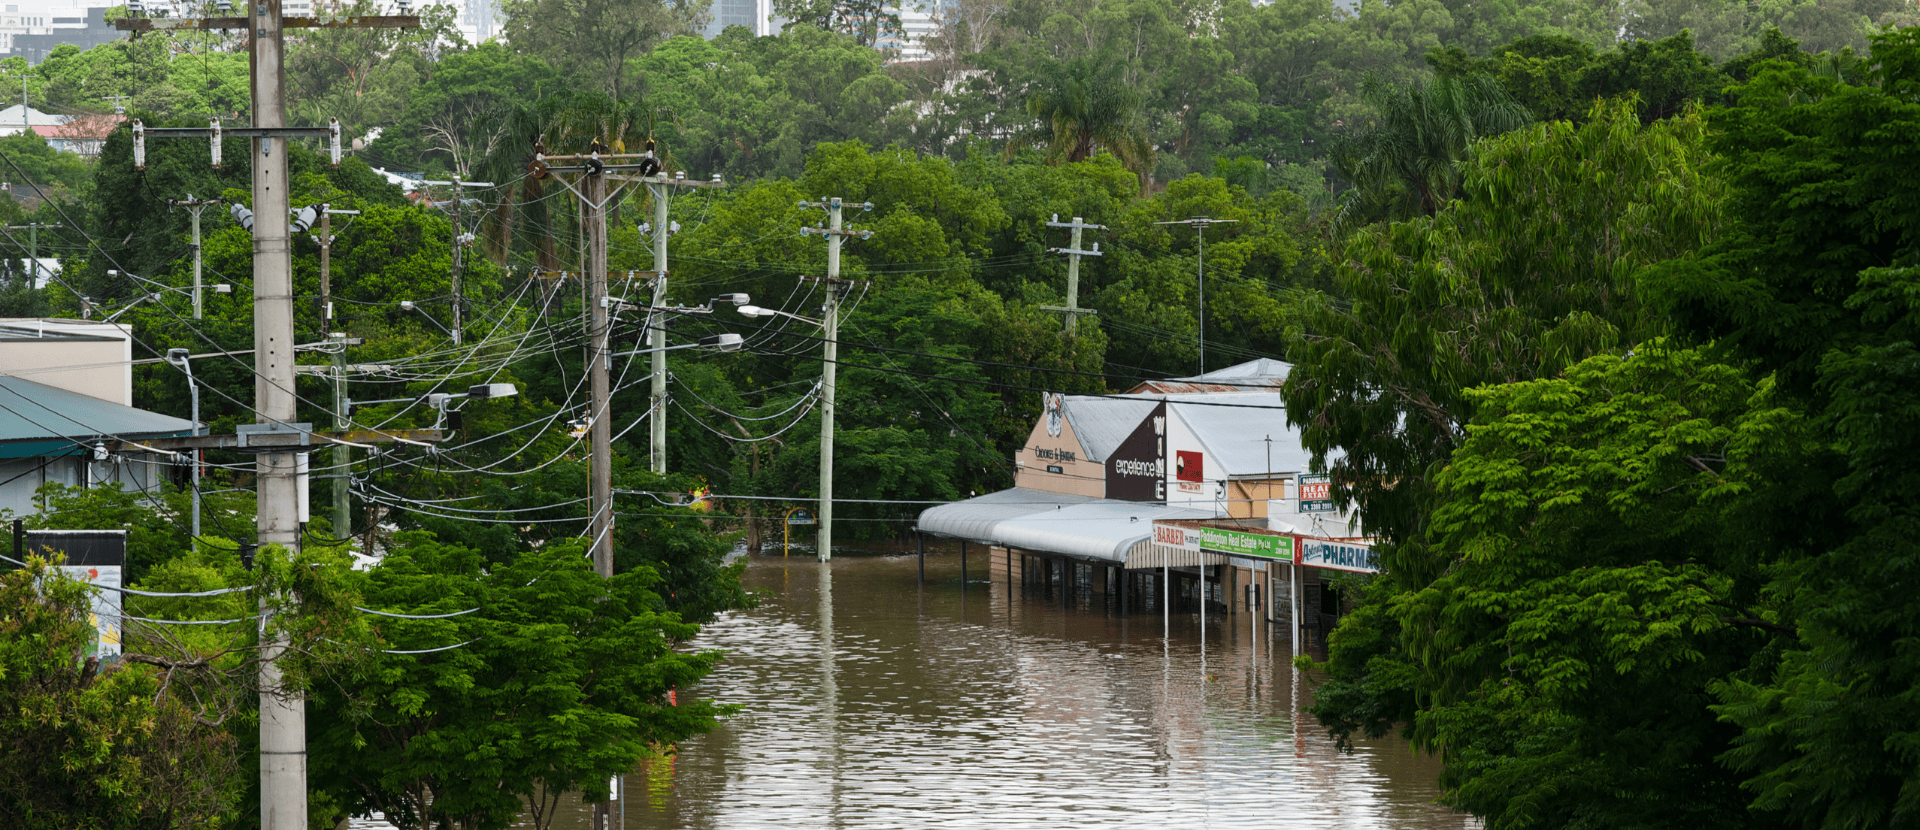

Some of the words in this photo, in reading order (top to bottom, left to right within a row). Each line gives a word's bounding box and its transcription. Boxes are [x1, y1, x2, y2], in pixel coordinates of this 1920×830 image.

[1116, 458, 1155, 478] experience
[1153, 416, 1165, 500] WINE
[1157, 526, 1184, 546] BARBER
[1201, 529, 1228, 547] Paddington
[1228, 533, 1240, 547] Real
[1240, 535, 1257, 549] Estate
[1323, 544, 1380, 571] PHARMA
